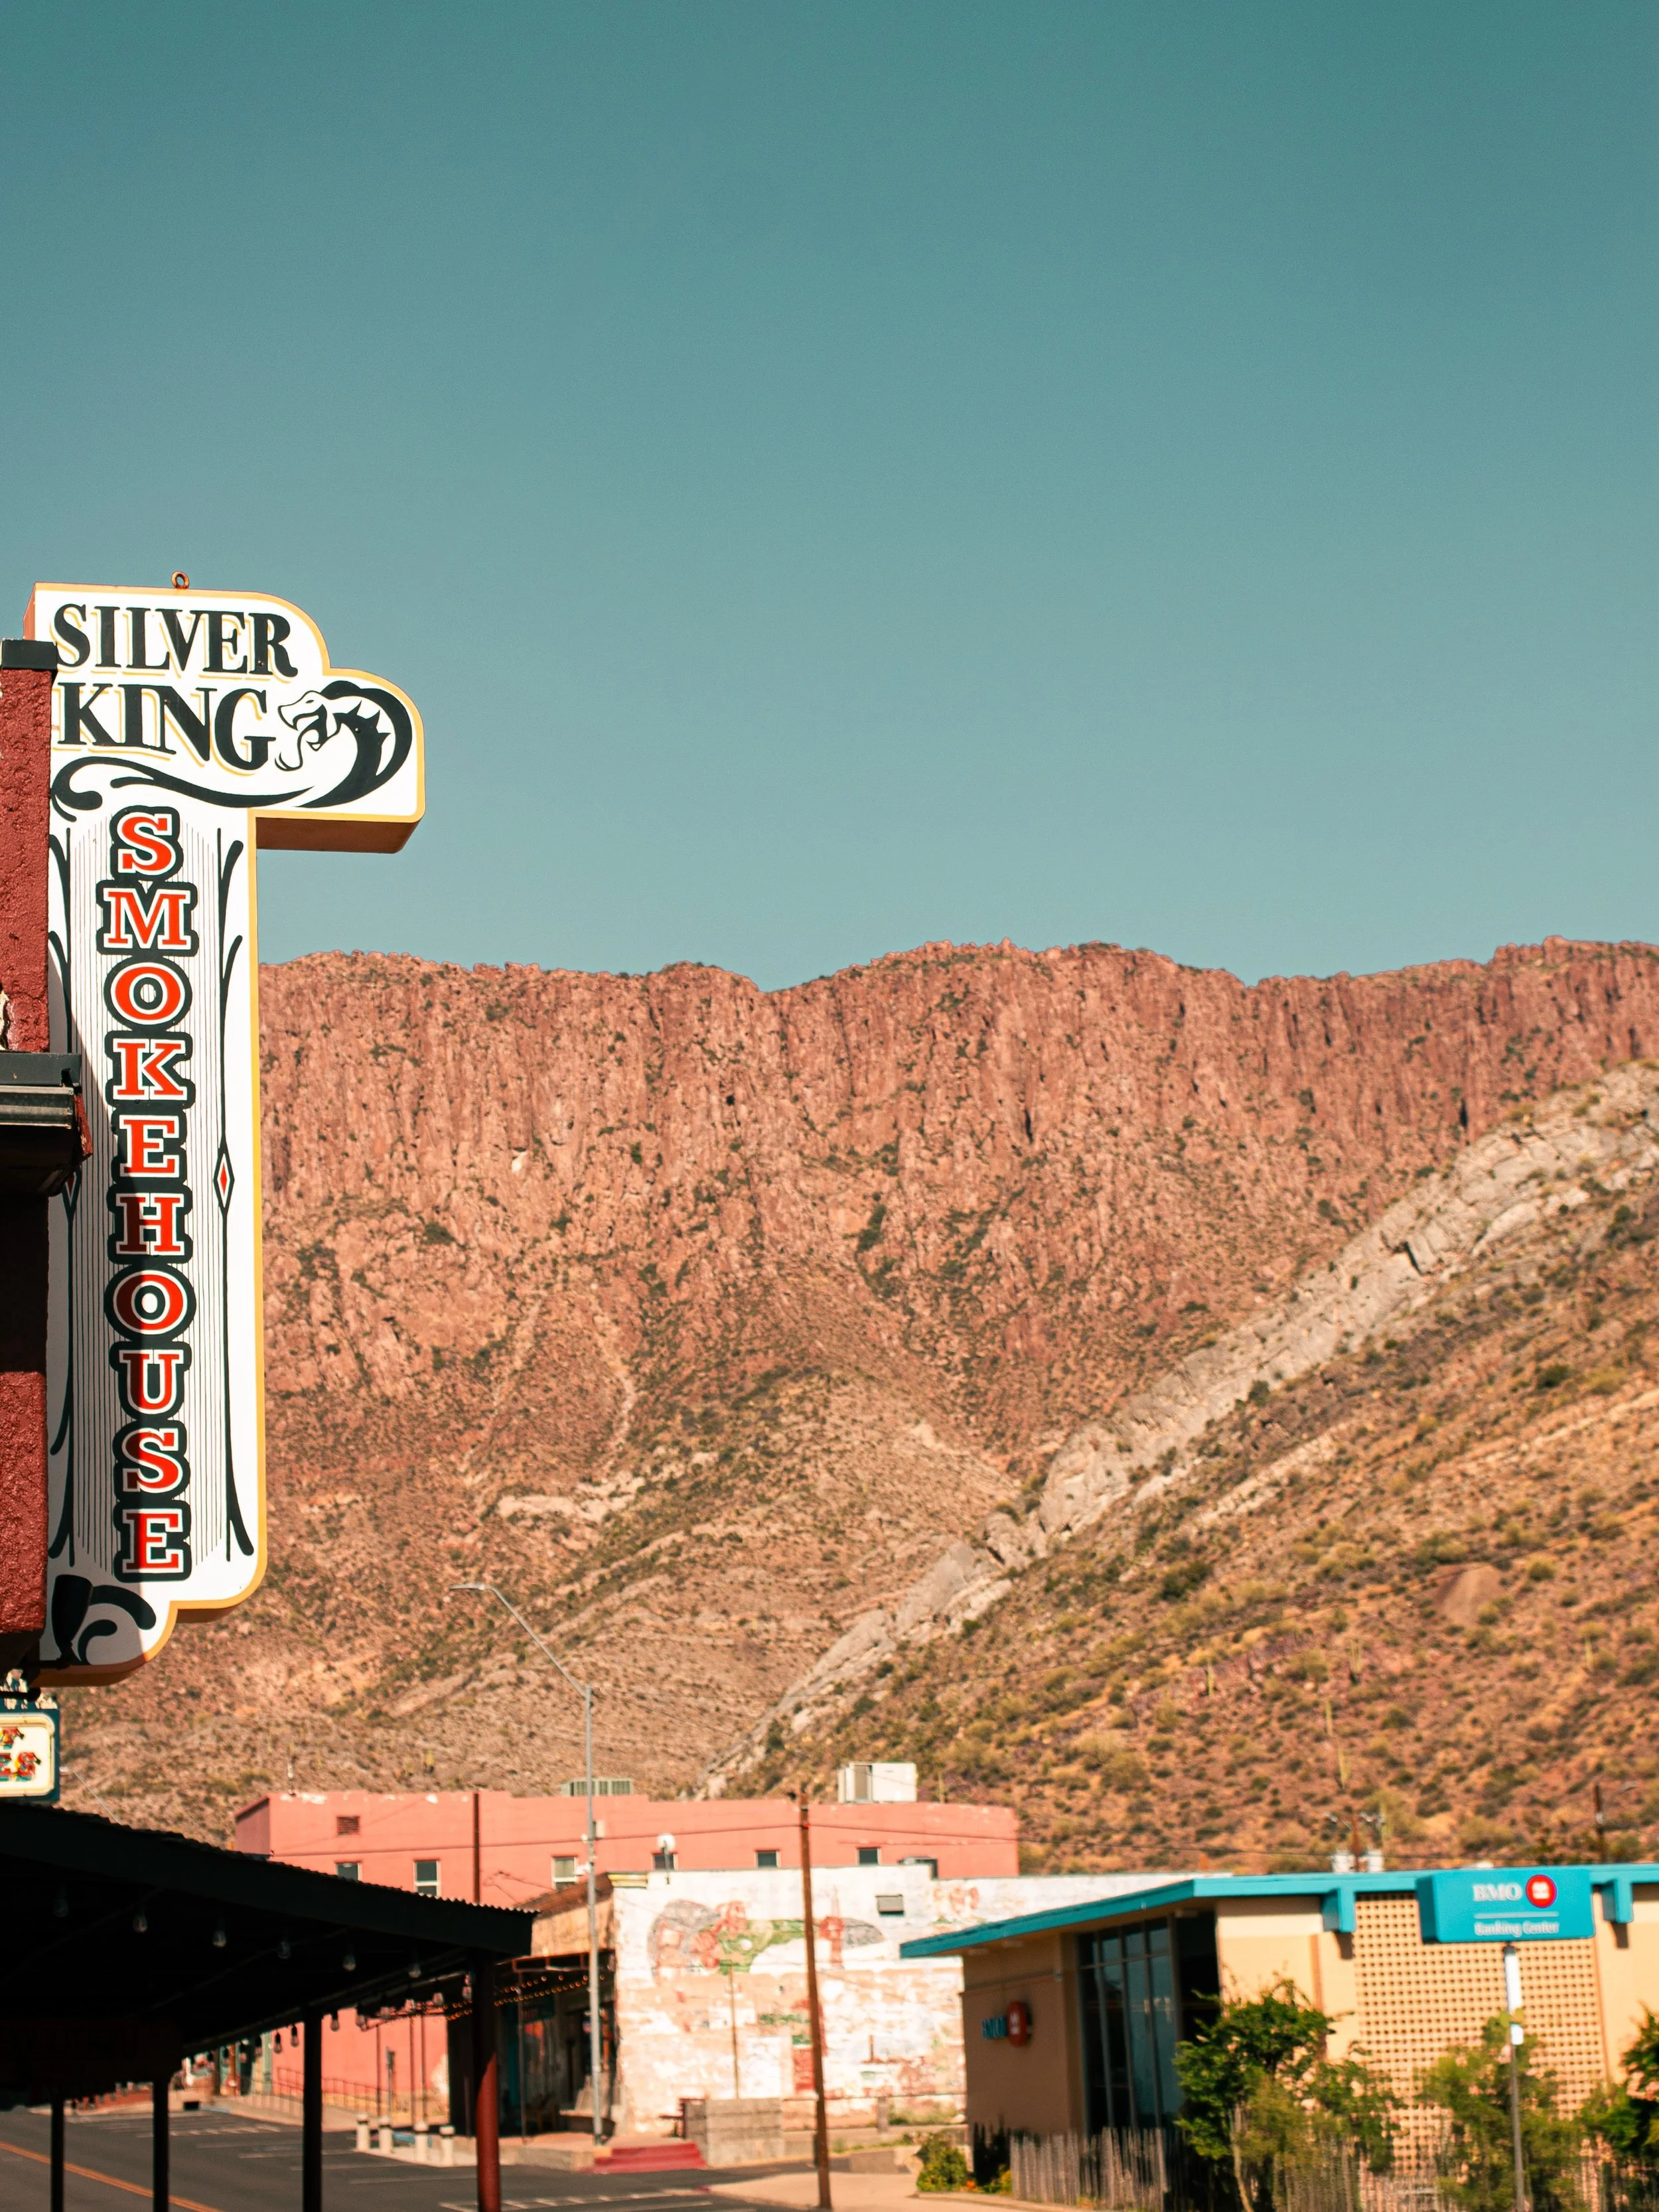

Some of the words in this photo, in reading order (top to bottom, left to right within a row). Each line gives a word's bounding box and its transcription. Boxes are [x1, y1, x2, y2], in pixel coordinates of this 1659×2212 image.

[54, 603, 298, 677] SILVER
[57, 682, 276, 771] KING
[98, 805, 196, 1584] SMOKEHOUSE
[1473, 1882, 1522, 1901] BMO
[1475, 1920, 1522, 1938] Banking
[1522, 1920, 1559, 1935] Center
